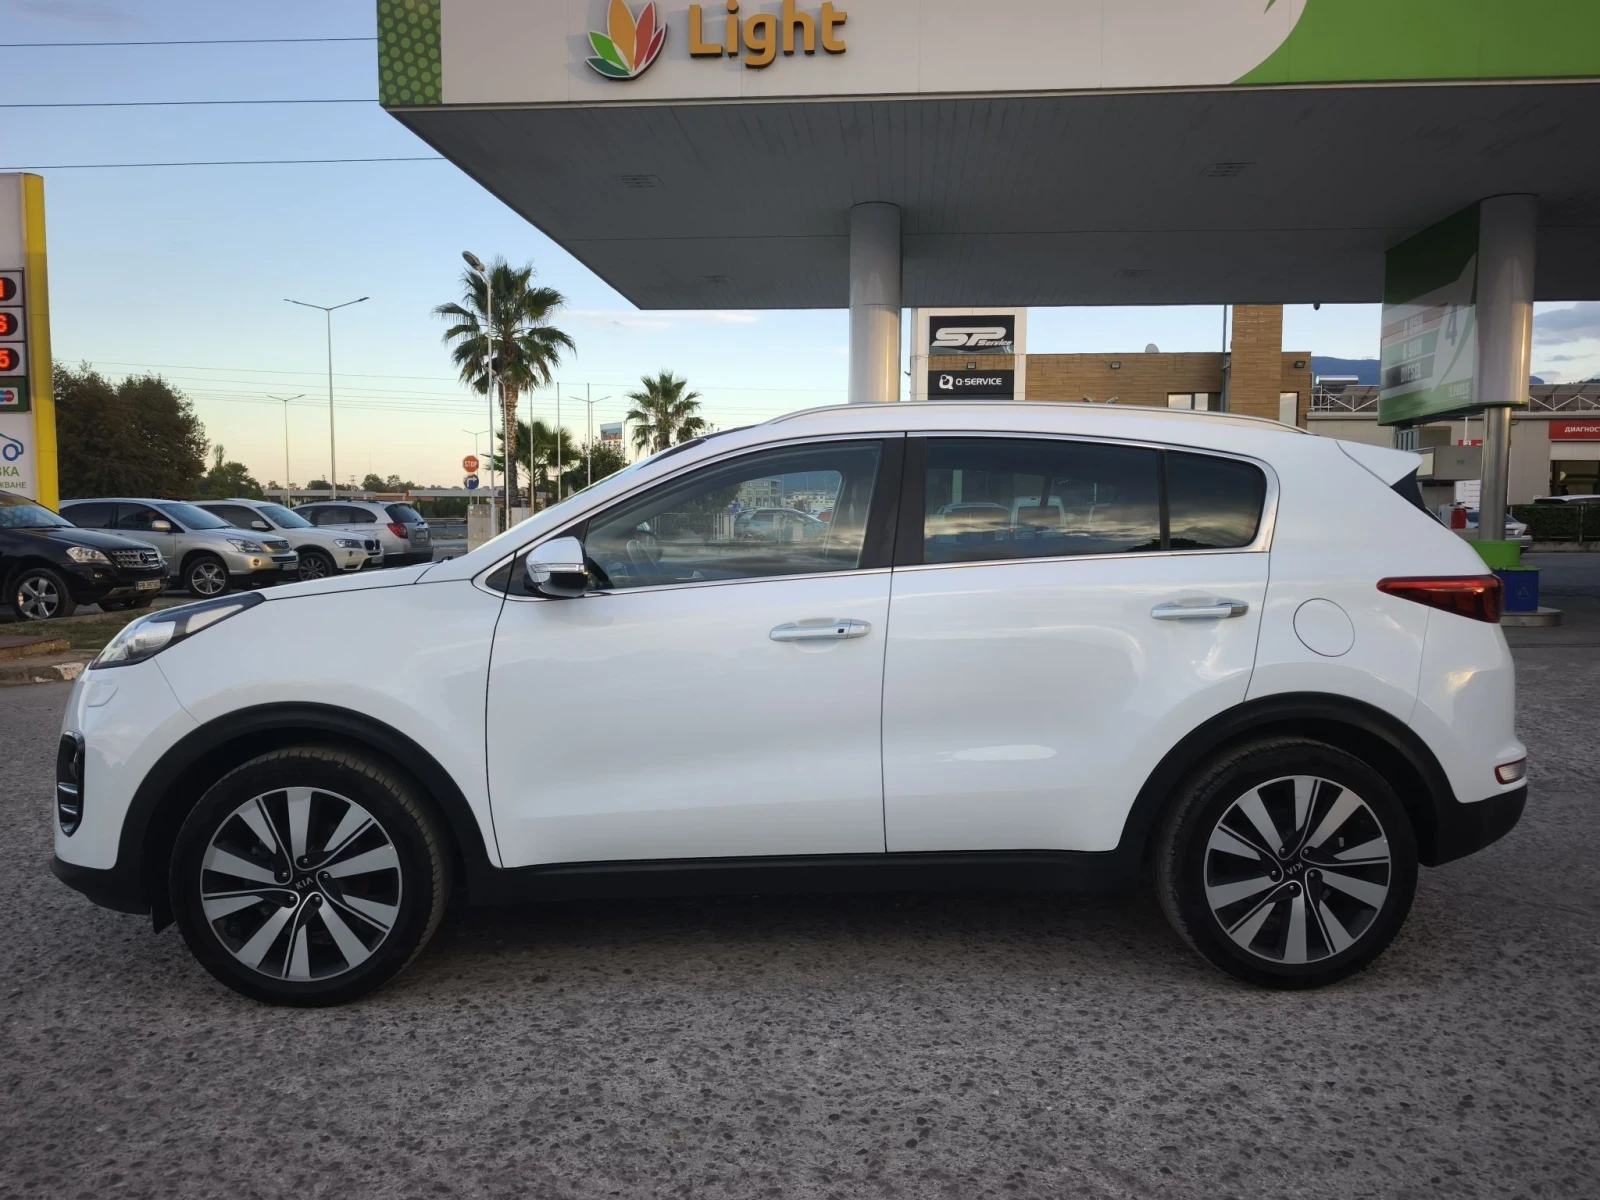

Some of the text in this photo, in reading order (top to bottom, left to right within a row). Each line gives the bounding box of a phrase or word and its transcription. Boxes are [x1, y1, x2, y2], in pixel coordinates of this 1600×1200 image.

[689, 0, 847, 68] Light
[1445, 304, 1458, 347] 4
[931, 327, 1006, 346] SP
[1400, 362, 1422, 384] DIESEL
[0, 466, 20, 477] КА
[1286, 862, 1303, 875] KIA
[295, 877, 314, 889] KIA
